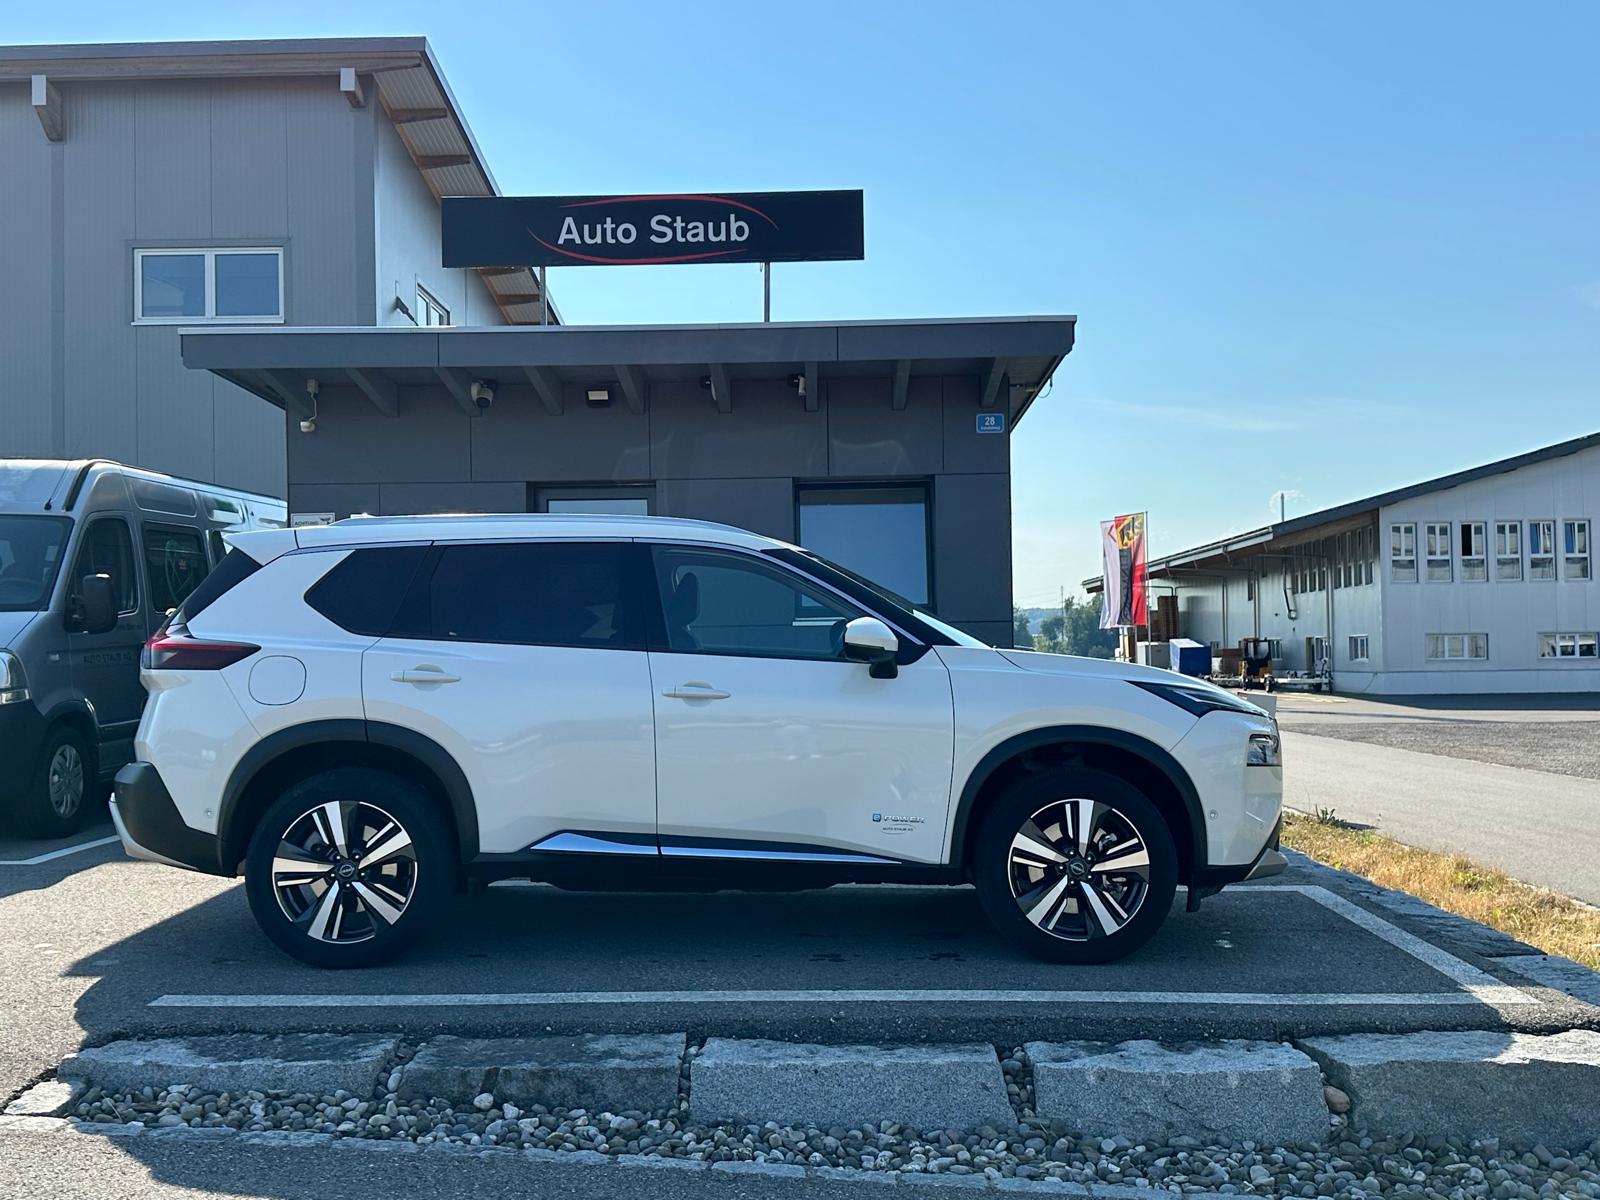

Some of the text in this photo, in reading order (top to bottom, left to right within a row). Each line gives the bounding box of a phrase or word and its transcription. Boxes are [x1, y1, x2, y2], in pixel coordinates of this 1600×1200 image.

[557, 213, 750, 245] Auto Staub
[984, 416, 996, 426] 28
[884, 815, 925, 824] POWER
